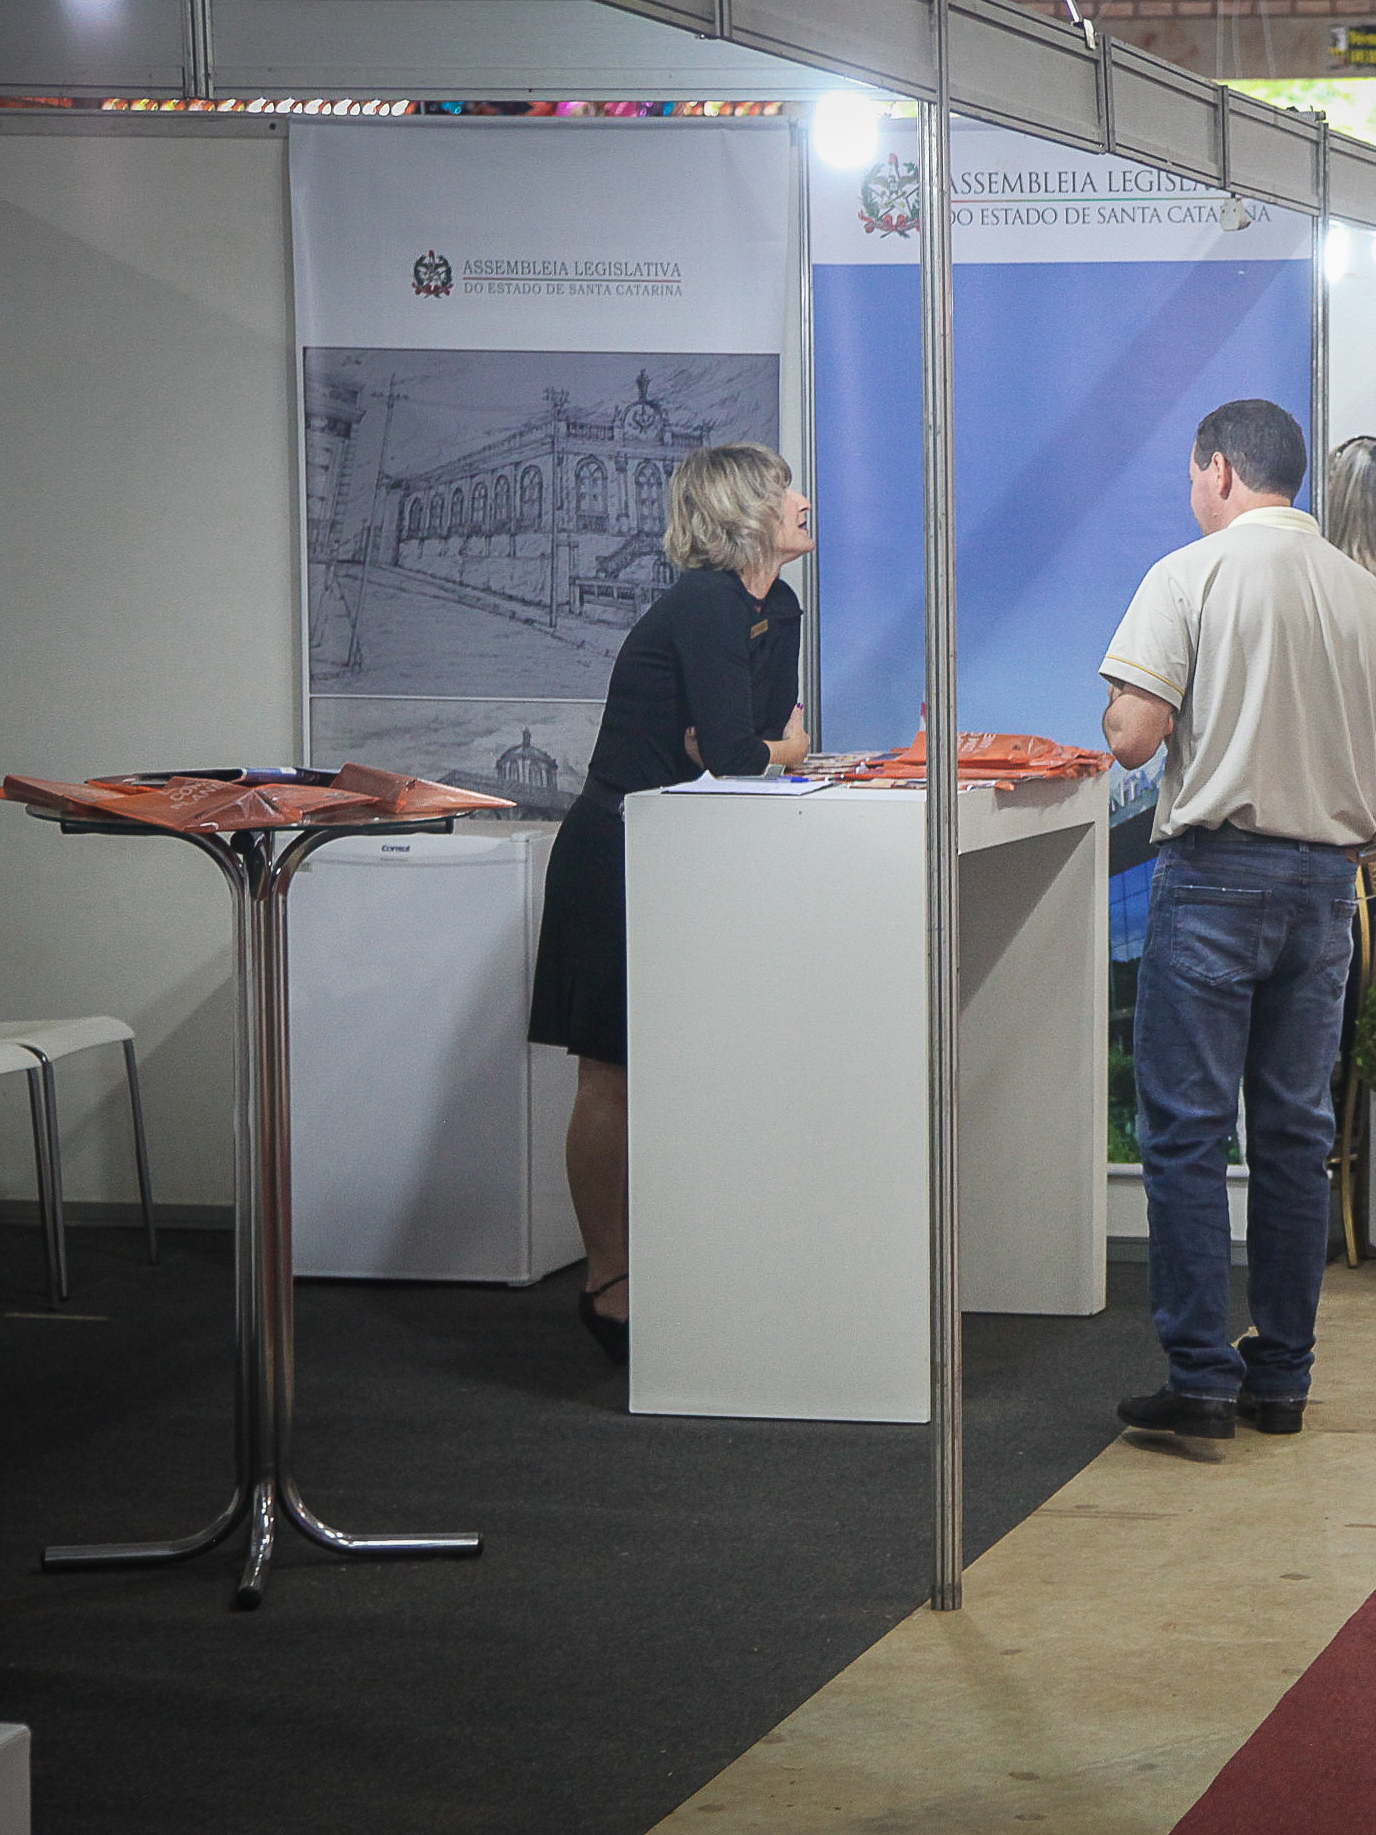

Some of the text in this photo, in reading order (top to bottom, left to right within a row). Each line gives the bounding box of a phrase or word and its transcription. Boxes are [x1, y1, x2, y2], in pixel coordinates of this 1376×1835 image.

[981, 207, 1058, 226] ESTADO
[1065, 206, 1091, 225] DE
[1097, 205, 1162, 224] SANTA
[463, 259, 682, 278] ASSEMBLEIA LEGISLATIVA
[464, 282, 683, 298] DO ESTADO DE SANTA CATARINA
